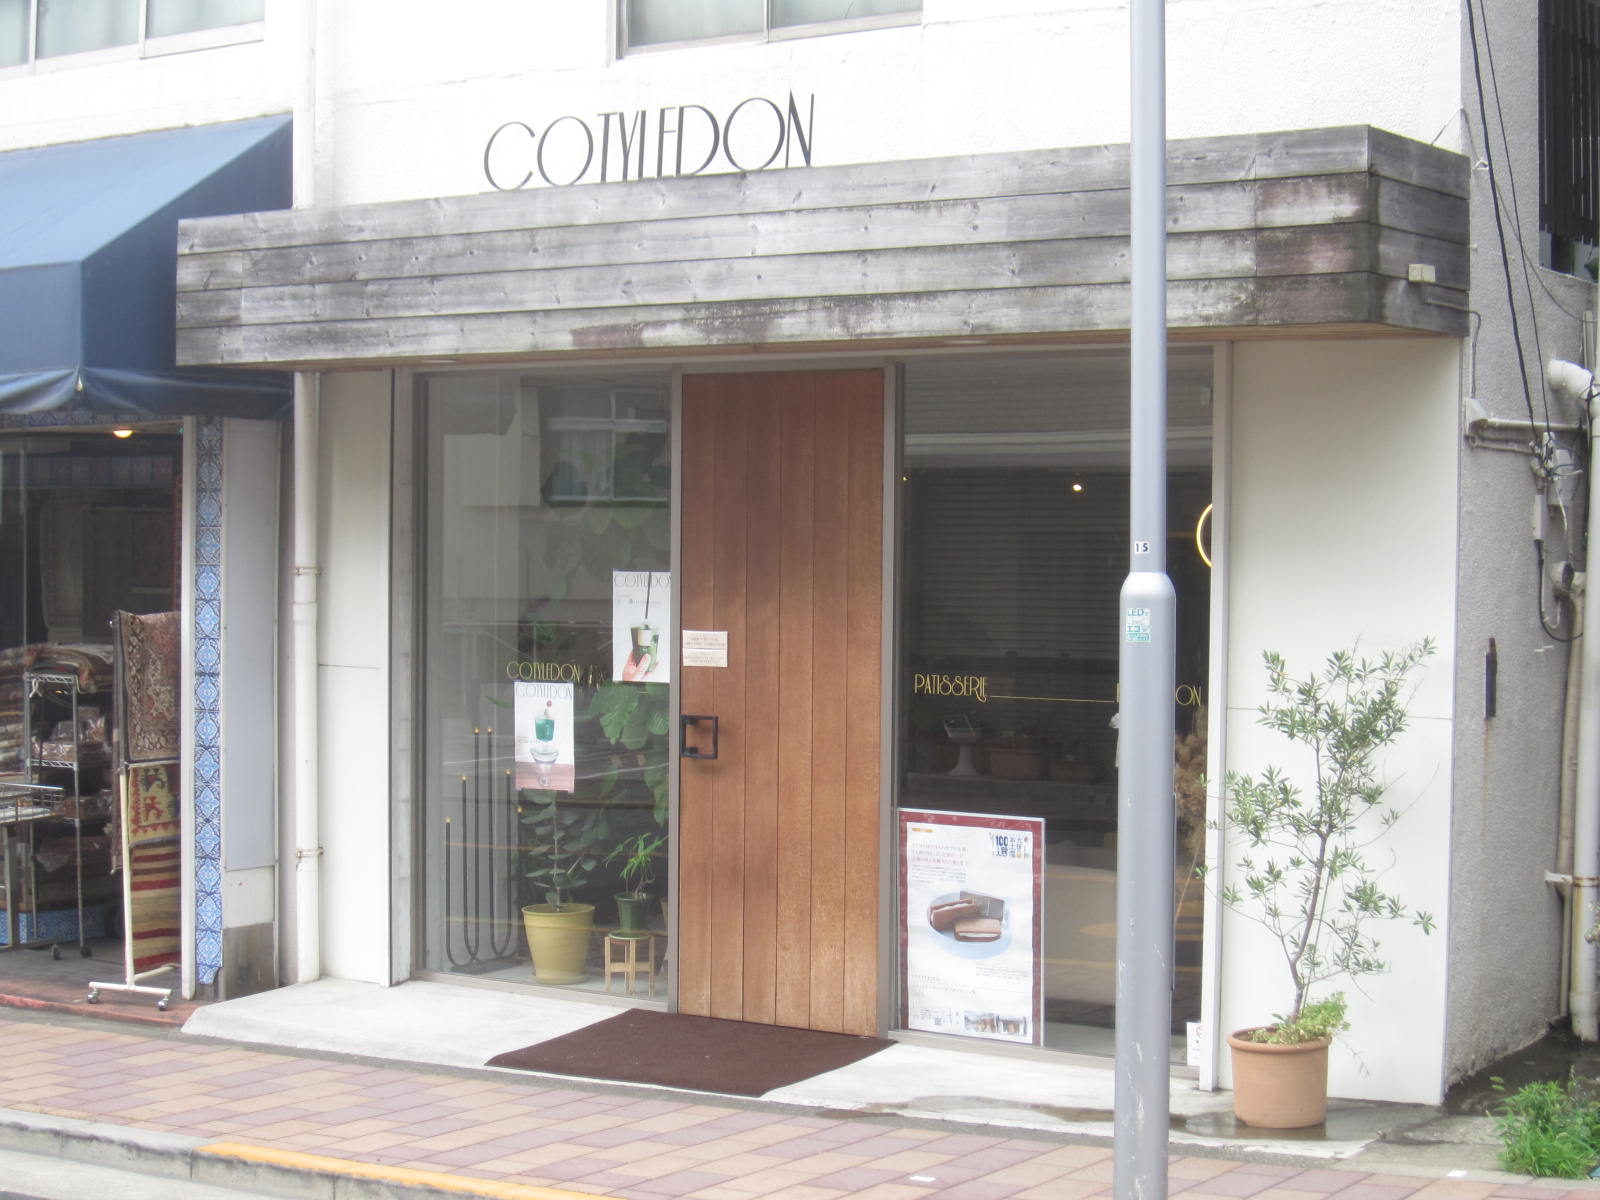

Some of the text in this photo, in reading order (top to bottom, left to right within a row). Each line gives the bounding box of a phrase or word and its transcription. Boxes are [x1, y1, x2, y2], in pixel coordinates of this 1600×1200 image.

[484, 88, 814, 191] COTYLEDON
[1136, 543, 1148, 553] 15
[613, 574, 671, 588] COTYLDO
[506, 661, 580, 683] COTYLEDON
[914, 673, 988, 702] PATISSERIE
[995, 835, 1009, 847] 100
